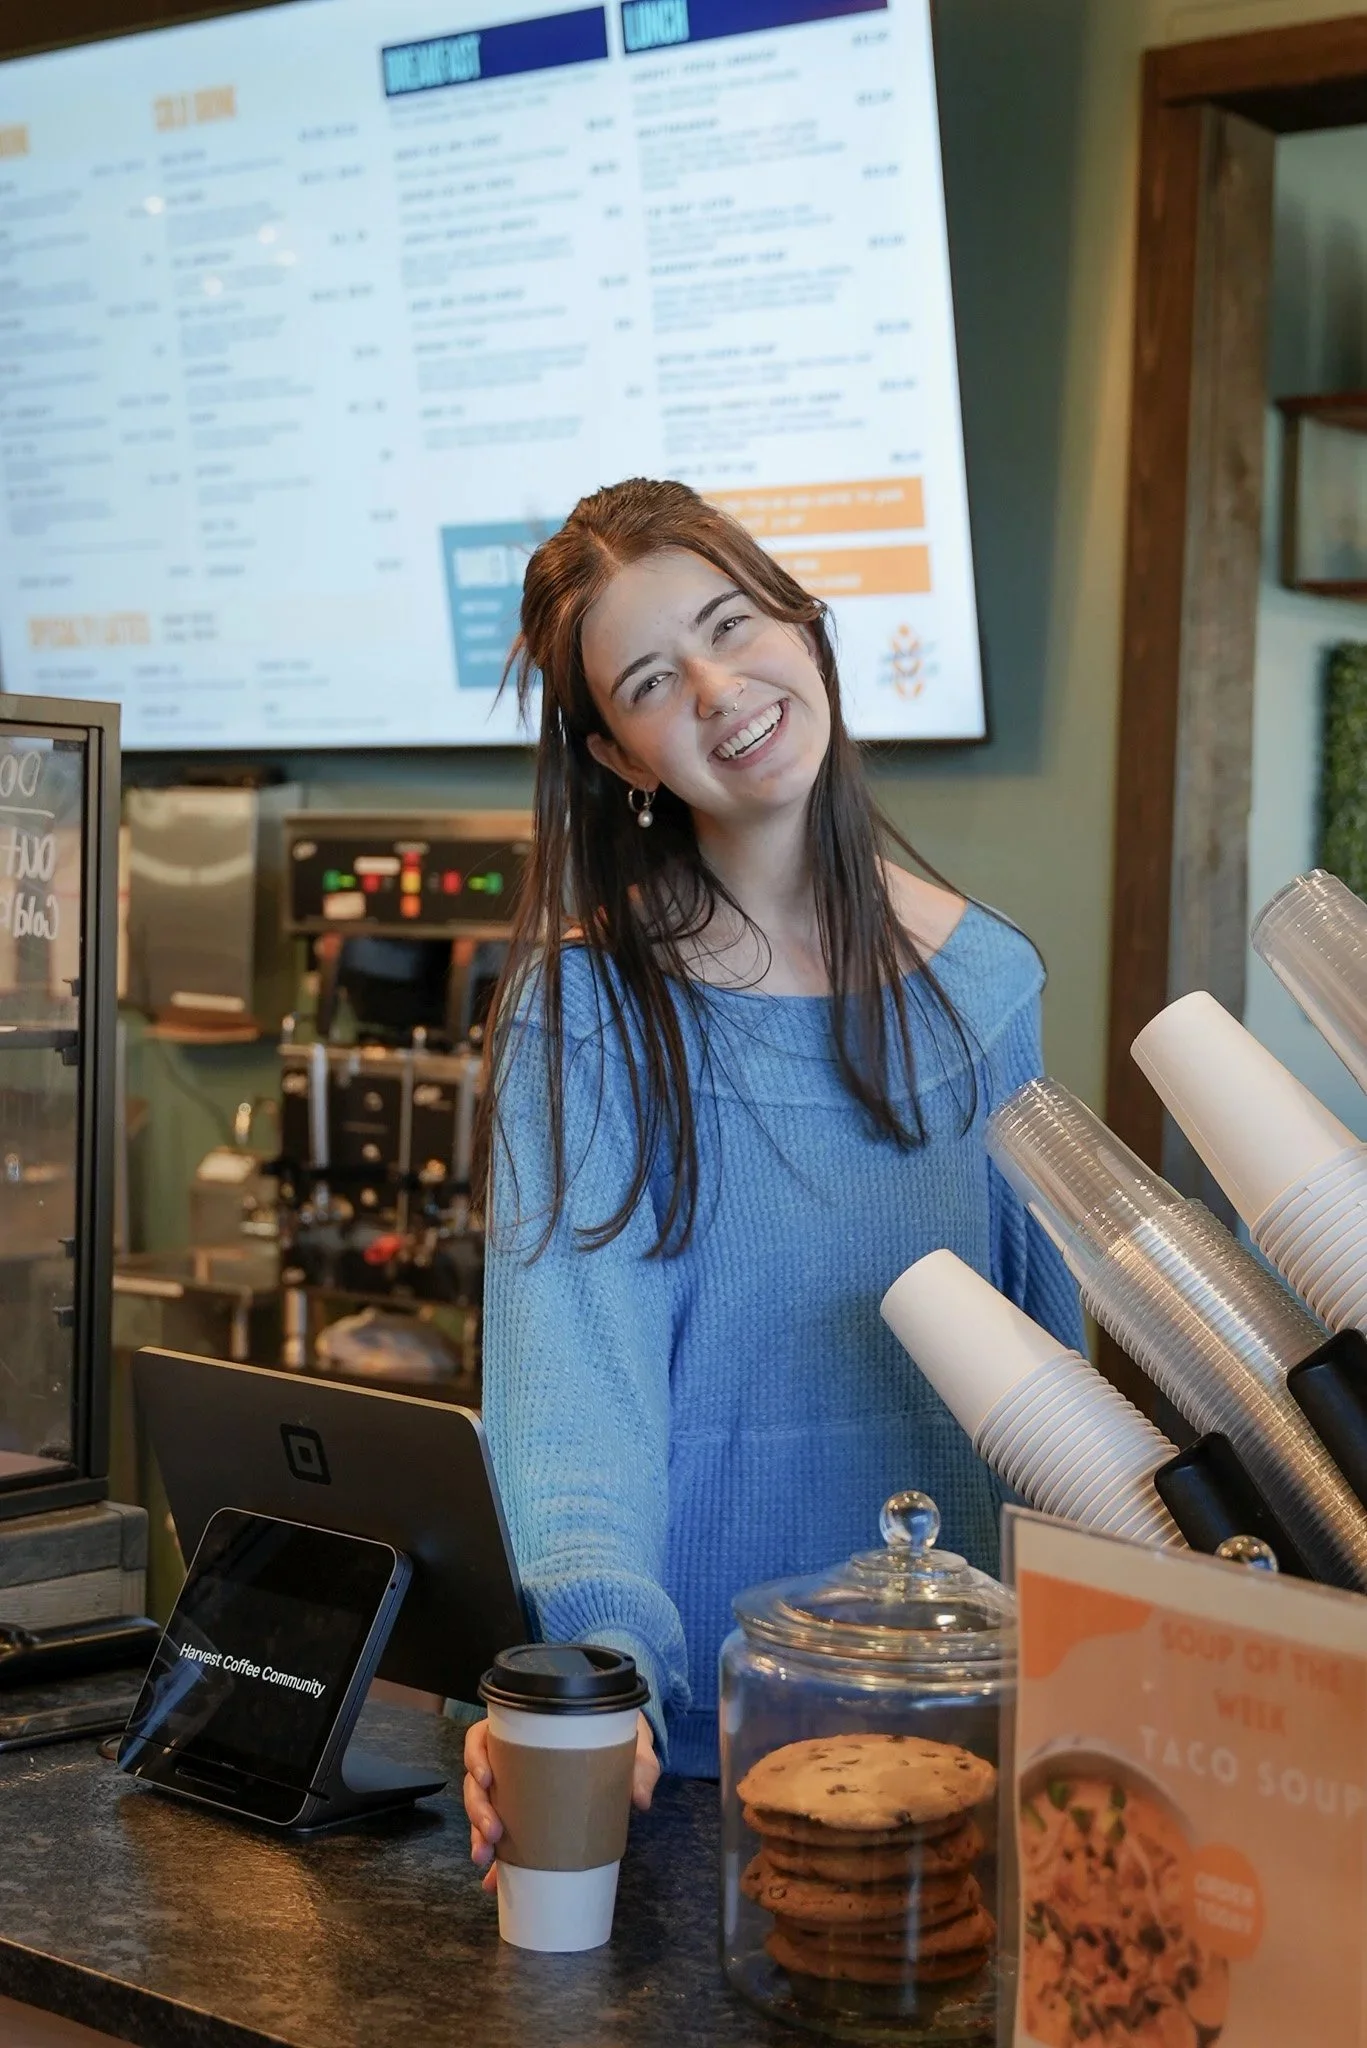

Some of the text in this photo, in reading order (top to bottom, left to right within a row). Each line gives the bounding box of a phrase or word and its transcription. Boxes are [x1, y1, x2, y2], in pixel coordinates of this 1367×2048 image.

[179, 1643, 326, 1698] Harvest Coffee Community
[1160, 1620, 1344, 1695] SOUP OF THE
[1215, 1690, 1287, 1735] WEEK
[1139, 1727, 1364, 1820] TACO SOUP
